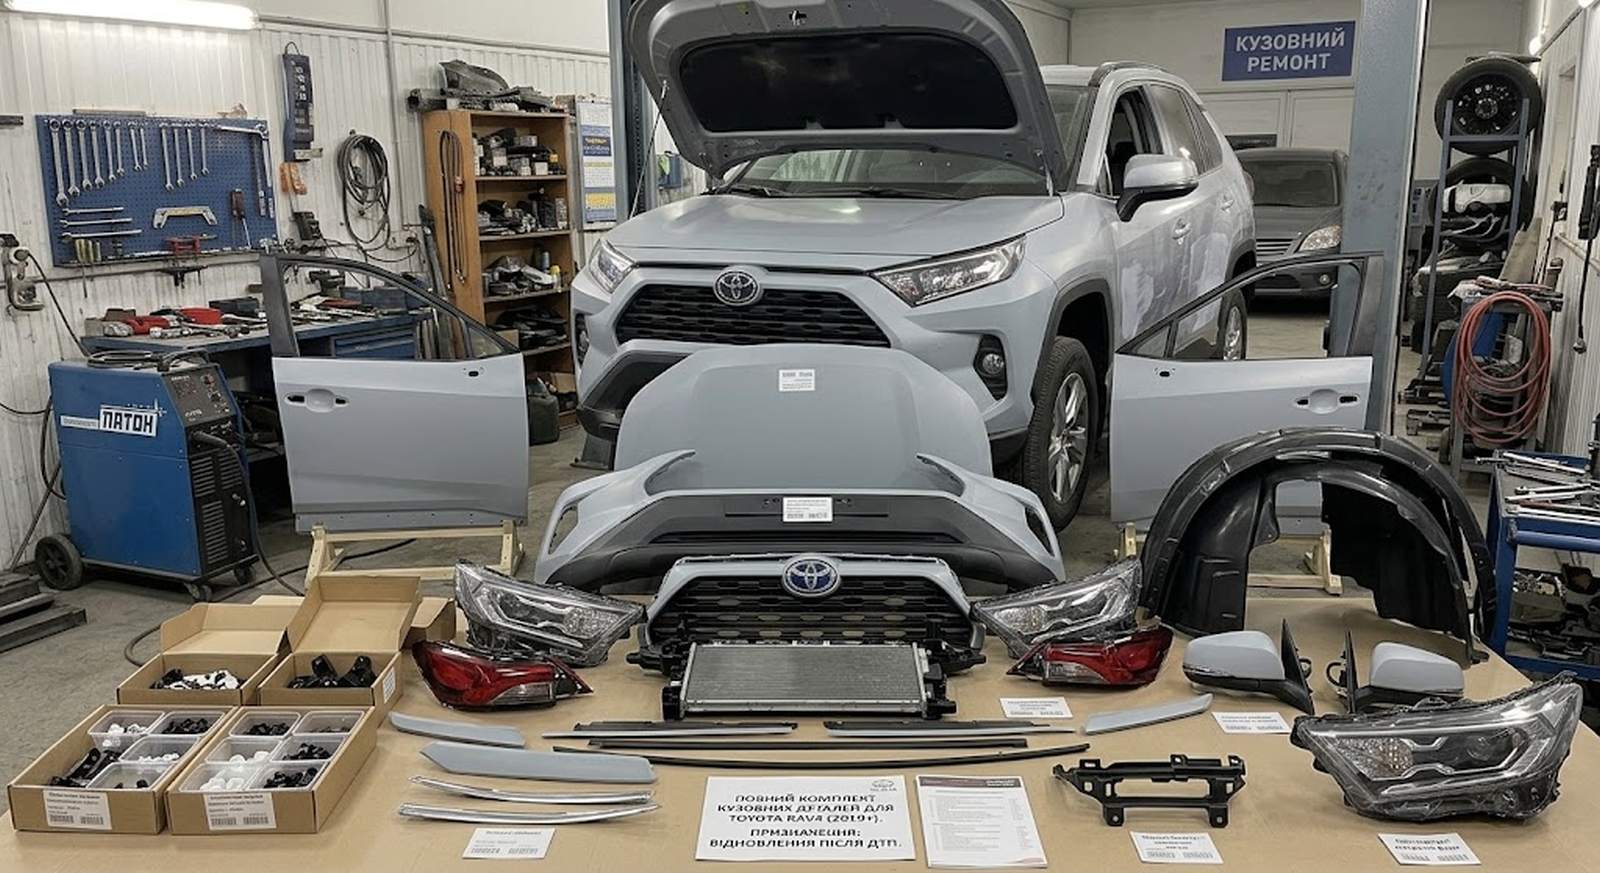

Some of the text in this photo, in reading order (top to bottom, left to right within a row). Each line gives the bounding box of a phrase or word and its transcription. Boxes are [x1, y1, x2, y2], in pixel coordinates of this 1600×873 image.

[1236, 27, 1345, 51] КУЗОВНИЙ
[1247, 53, 1331, 72] РЕМОНТ
[102, 410, 154, 433] ПАТОН
[718, 804, 792, 812] КУЗОВНИХ
[863, 804, 894, 813] ДЛЯ
[728, 814, 783, 822] TOYOTA
[787, 814, 823, 822] RAV4
[710, 839, 815, 849] ВІДНОВЛЕННЯ
[819, 839, 864, 848] ПІСЛЯ
